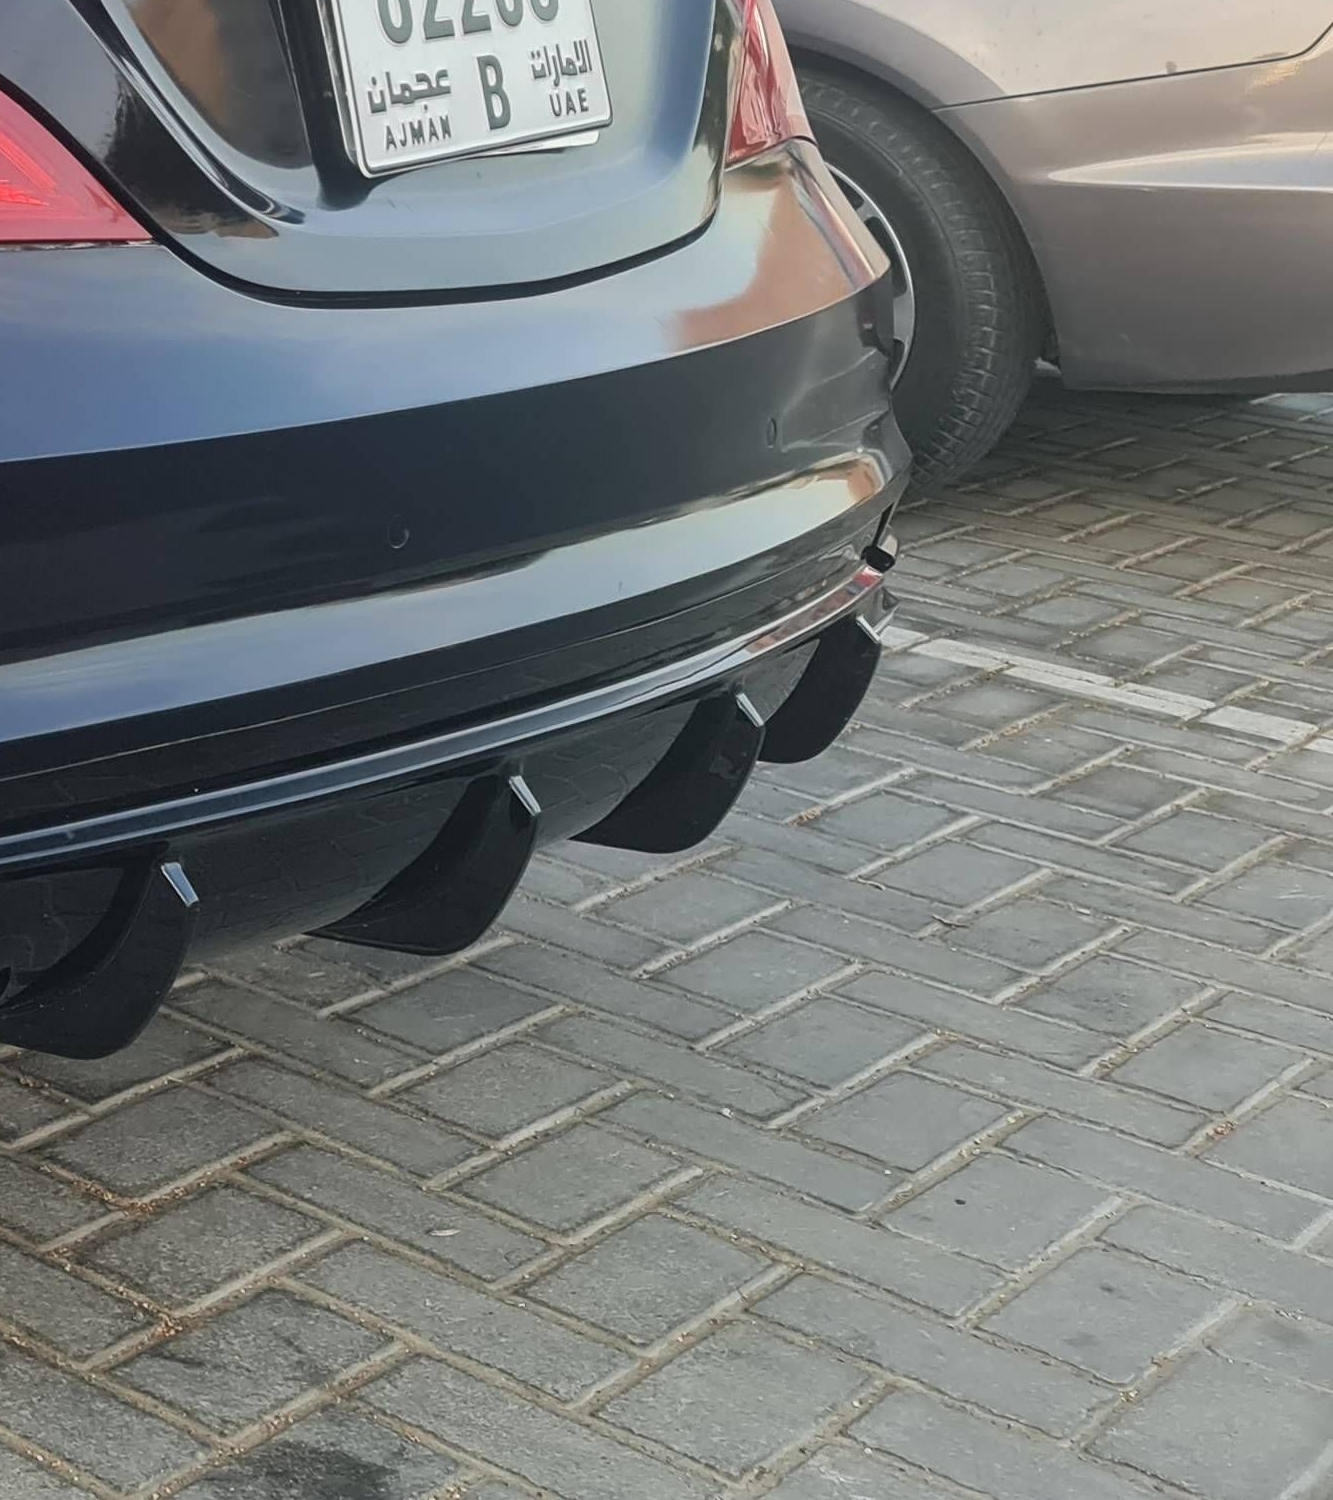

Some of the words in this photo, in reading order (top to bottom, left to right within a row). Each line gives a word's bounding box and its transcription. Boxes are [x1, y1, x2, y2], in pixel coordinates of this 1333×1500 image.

[366, 68, 452, 115] عجمان
[476, 54, 512, 131] B
[549, 88, 589, 117] UAE
[385, 114, 452, 151] AJMAN
